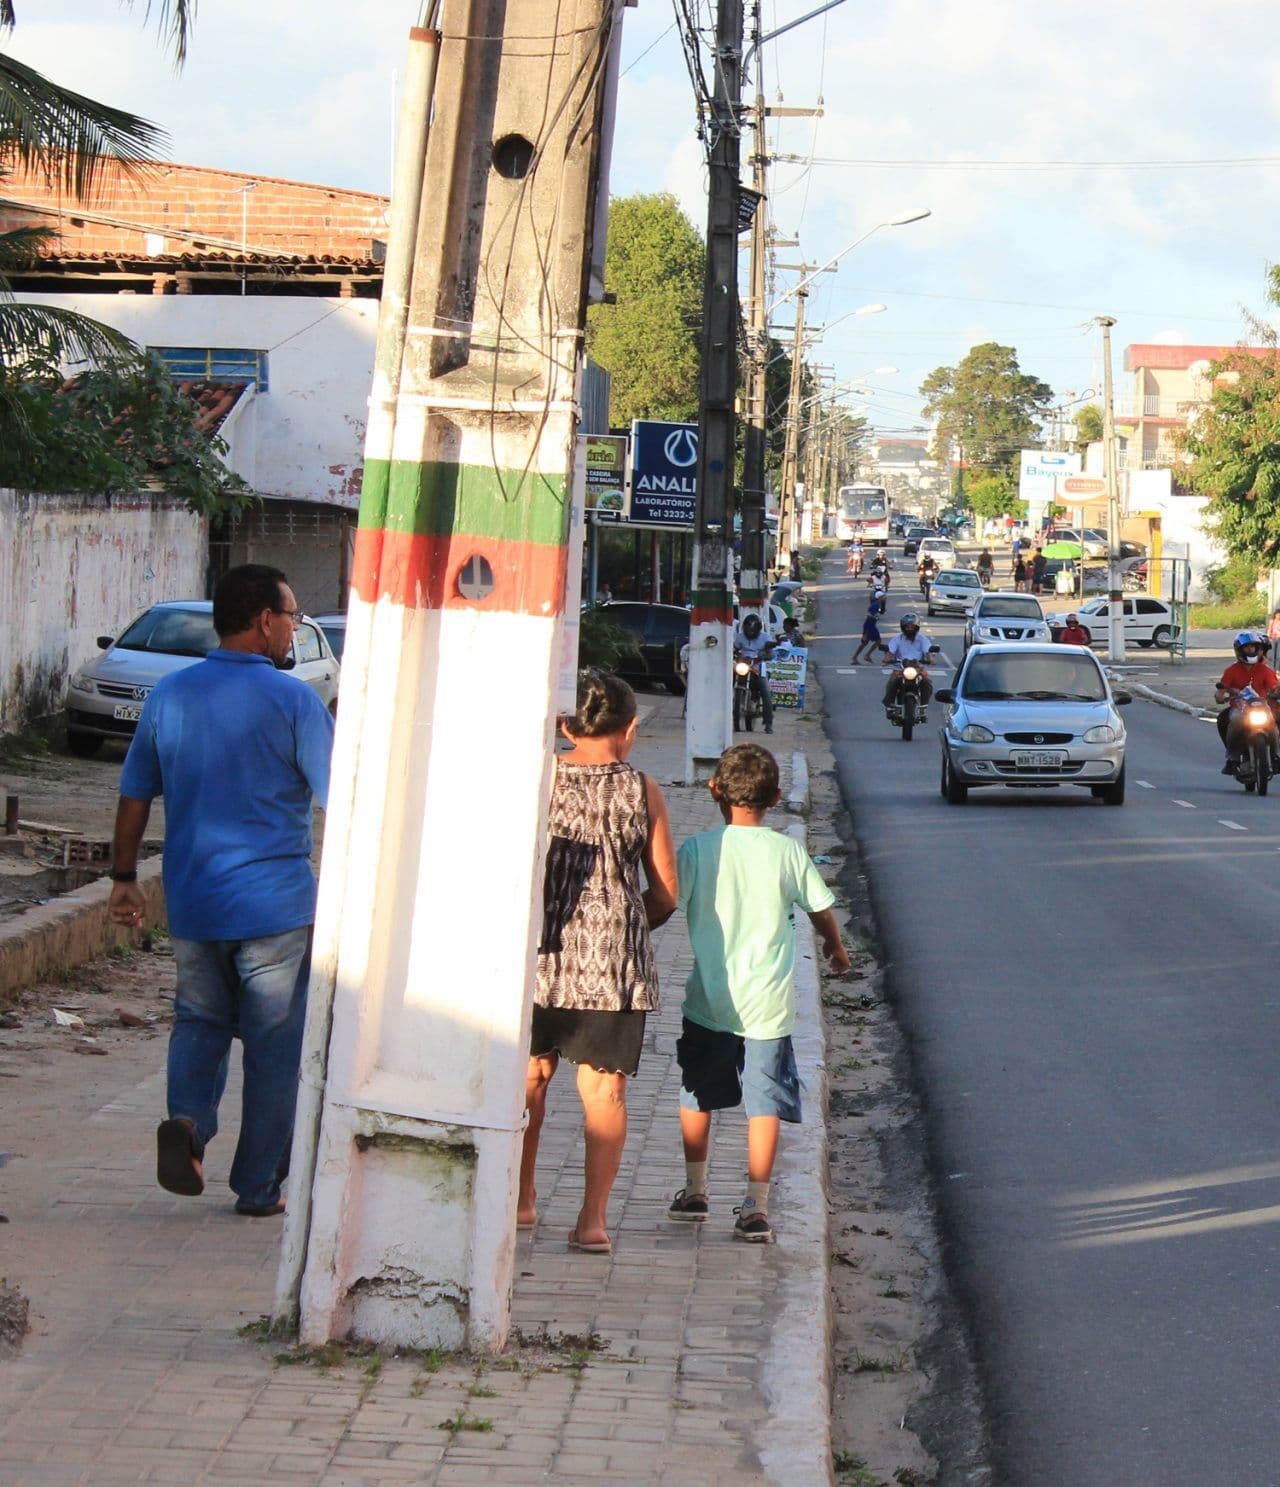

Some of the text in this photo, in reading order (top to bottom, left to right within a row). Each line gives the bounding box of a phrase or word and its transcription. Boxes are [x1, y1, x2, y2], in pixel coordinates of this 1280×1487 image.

[636, 474, 697, 493] ANALI
[635, 497, 692, 507] LABORATÓRIO
[649, 509, 695, 519] Tel 3232-5
[115, 709, 141, 719] HIX-2
